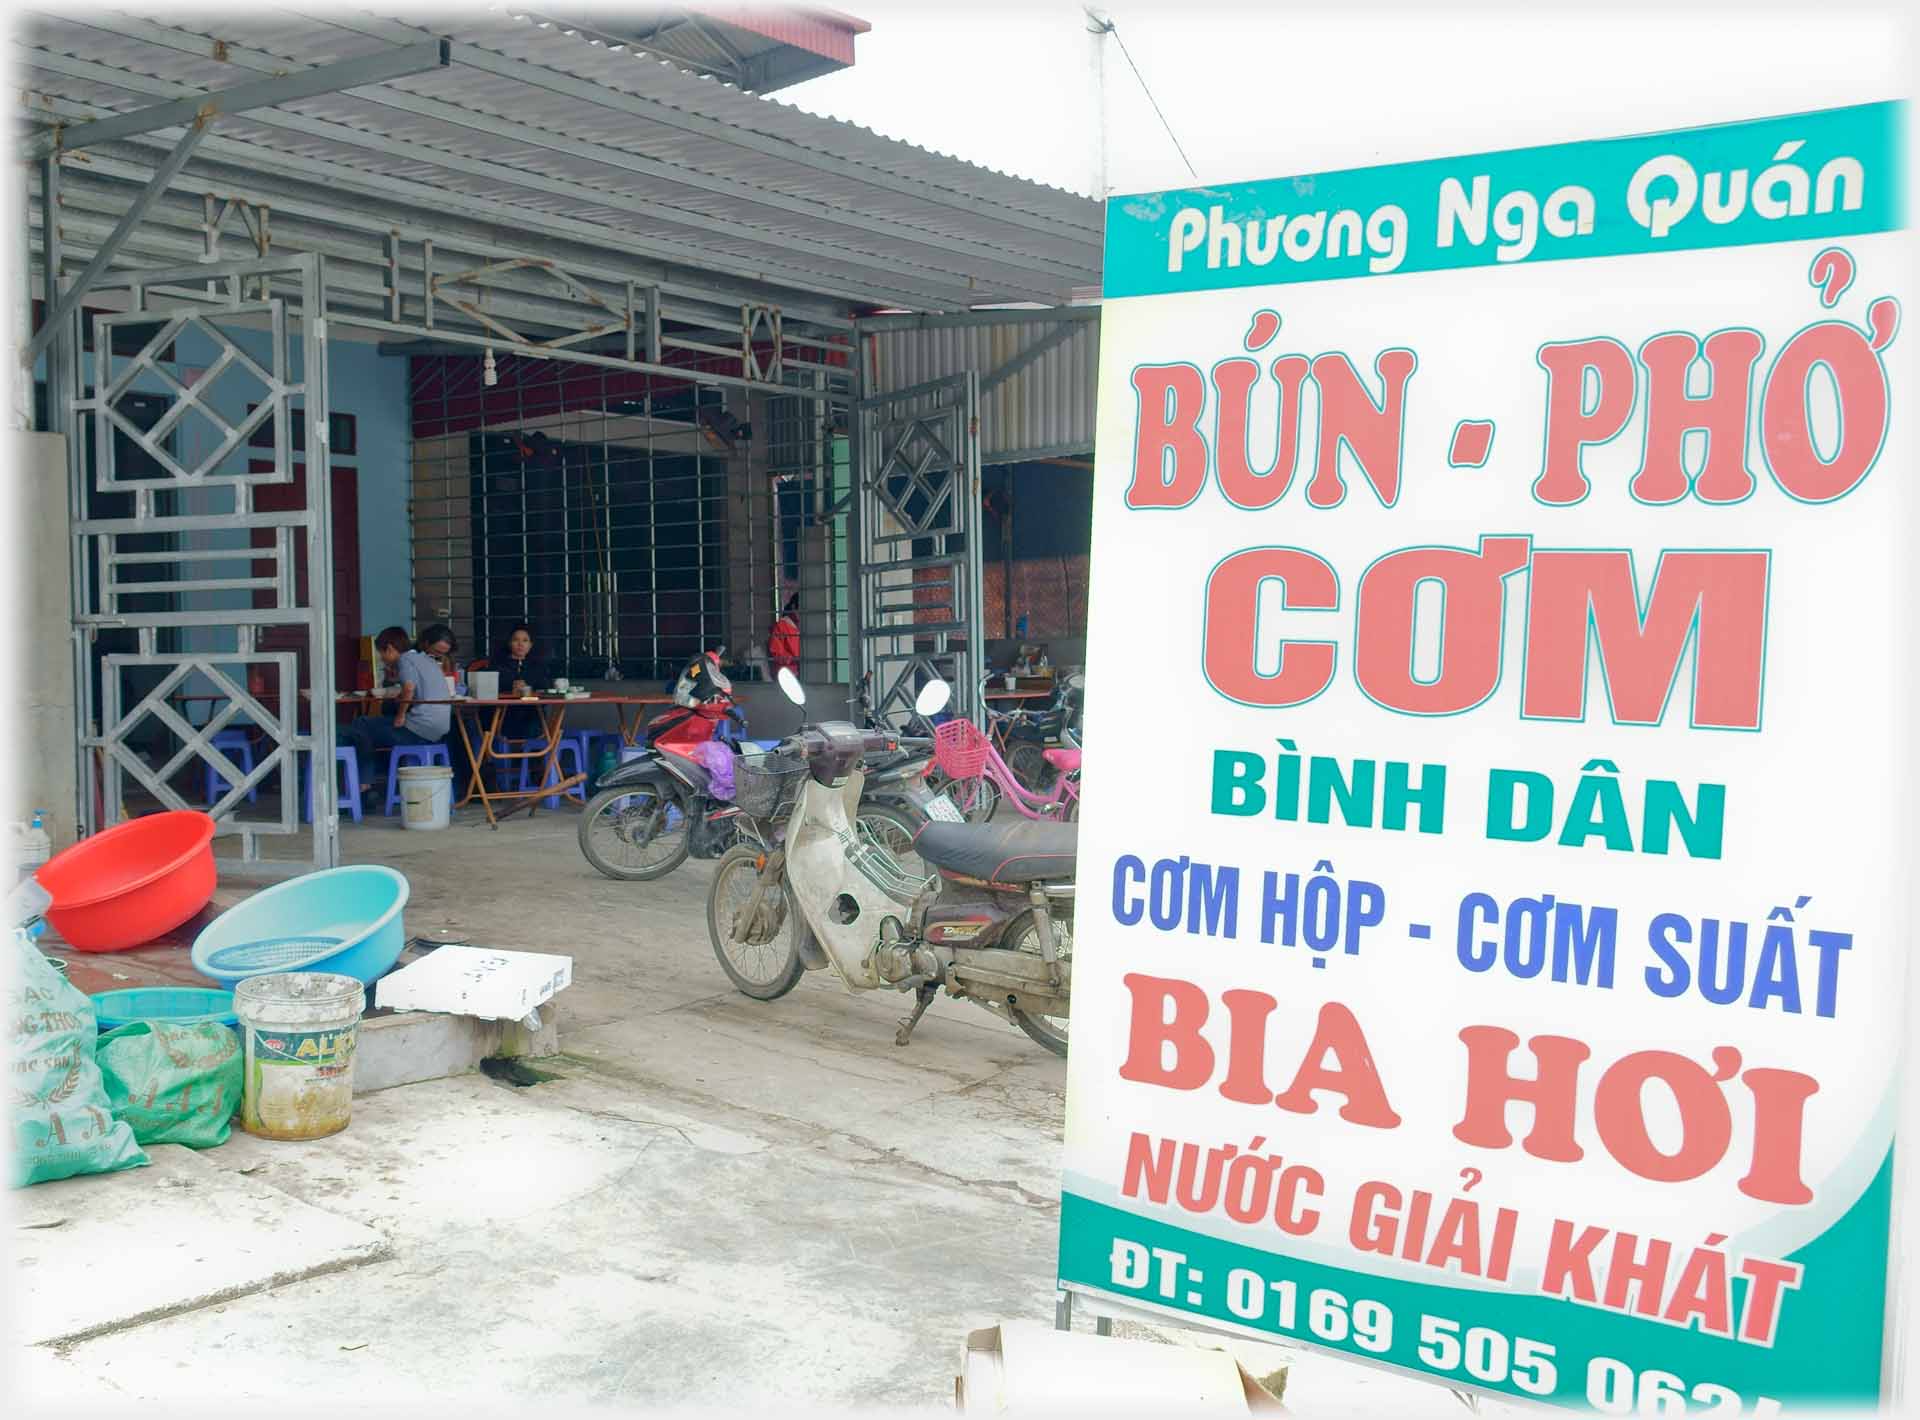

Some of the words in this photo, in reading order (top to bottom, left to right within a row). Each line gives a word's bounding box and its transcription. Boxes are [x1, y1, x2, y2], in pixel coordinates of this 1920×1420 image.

[1168, 205, 1408, 273] Phương
[1437, 175, 1596, 262] Nga
[1627, 140, 1864, 238] Quán
[1125, 309, 1418, 510] BÚN
[1533, 248, 1900, 506] PHỞ
[1202, 535, 1772, 733] CƠM
[1210, 737, 1448, 836] BÌNH
[1484, 758, 1727, 861] DÂN
[1112, 855, 1240, 939] CƠM
[1260, 859, 1386, 969] HỘP
[1456, 891, 1617, 989] CƠM
[1644, 895, 1853, 1018] SUẤT
[1119, 972, 1401, 1128] BIA
[1452, 1026, 1820, 1205] HƠI
[1110, 1238, 1203, 1305] ĐT:
[1227, 1269, 1393, 1352] 0169
[1418, 1314, 1557, 1395] 505
[1121, 1132, 1324, 1237] NƯỚC
[1348, 1167, 1518, 1282] GIẢI
[1539, 1218, 1802, 1347] KHÁT
